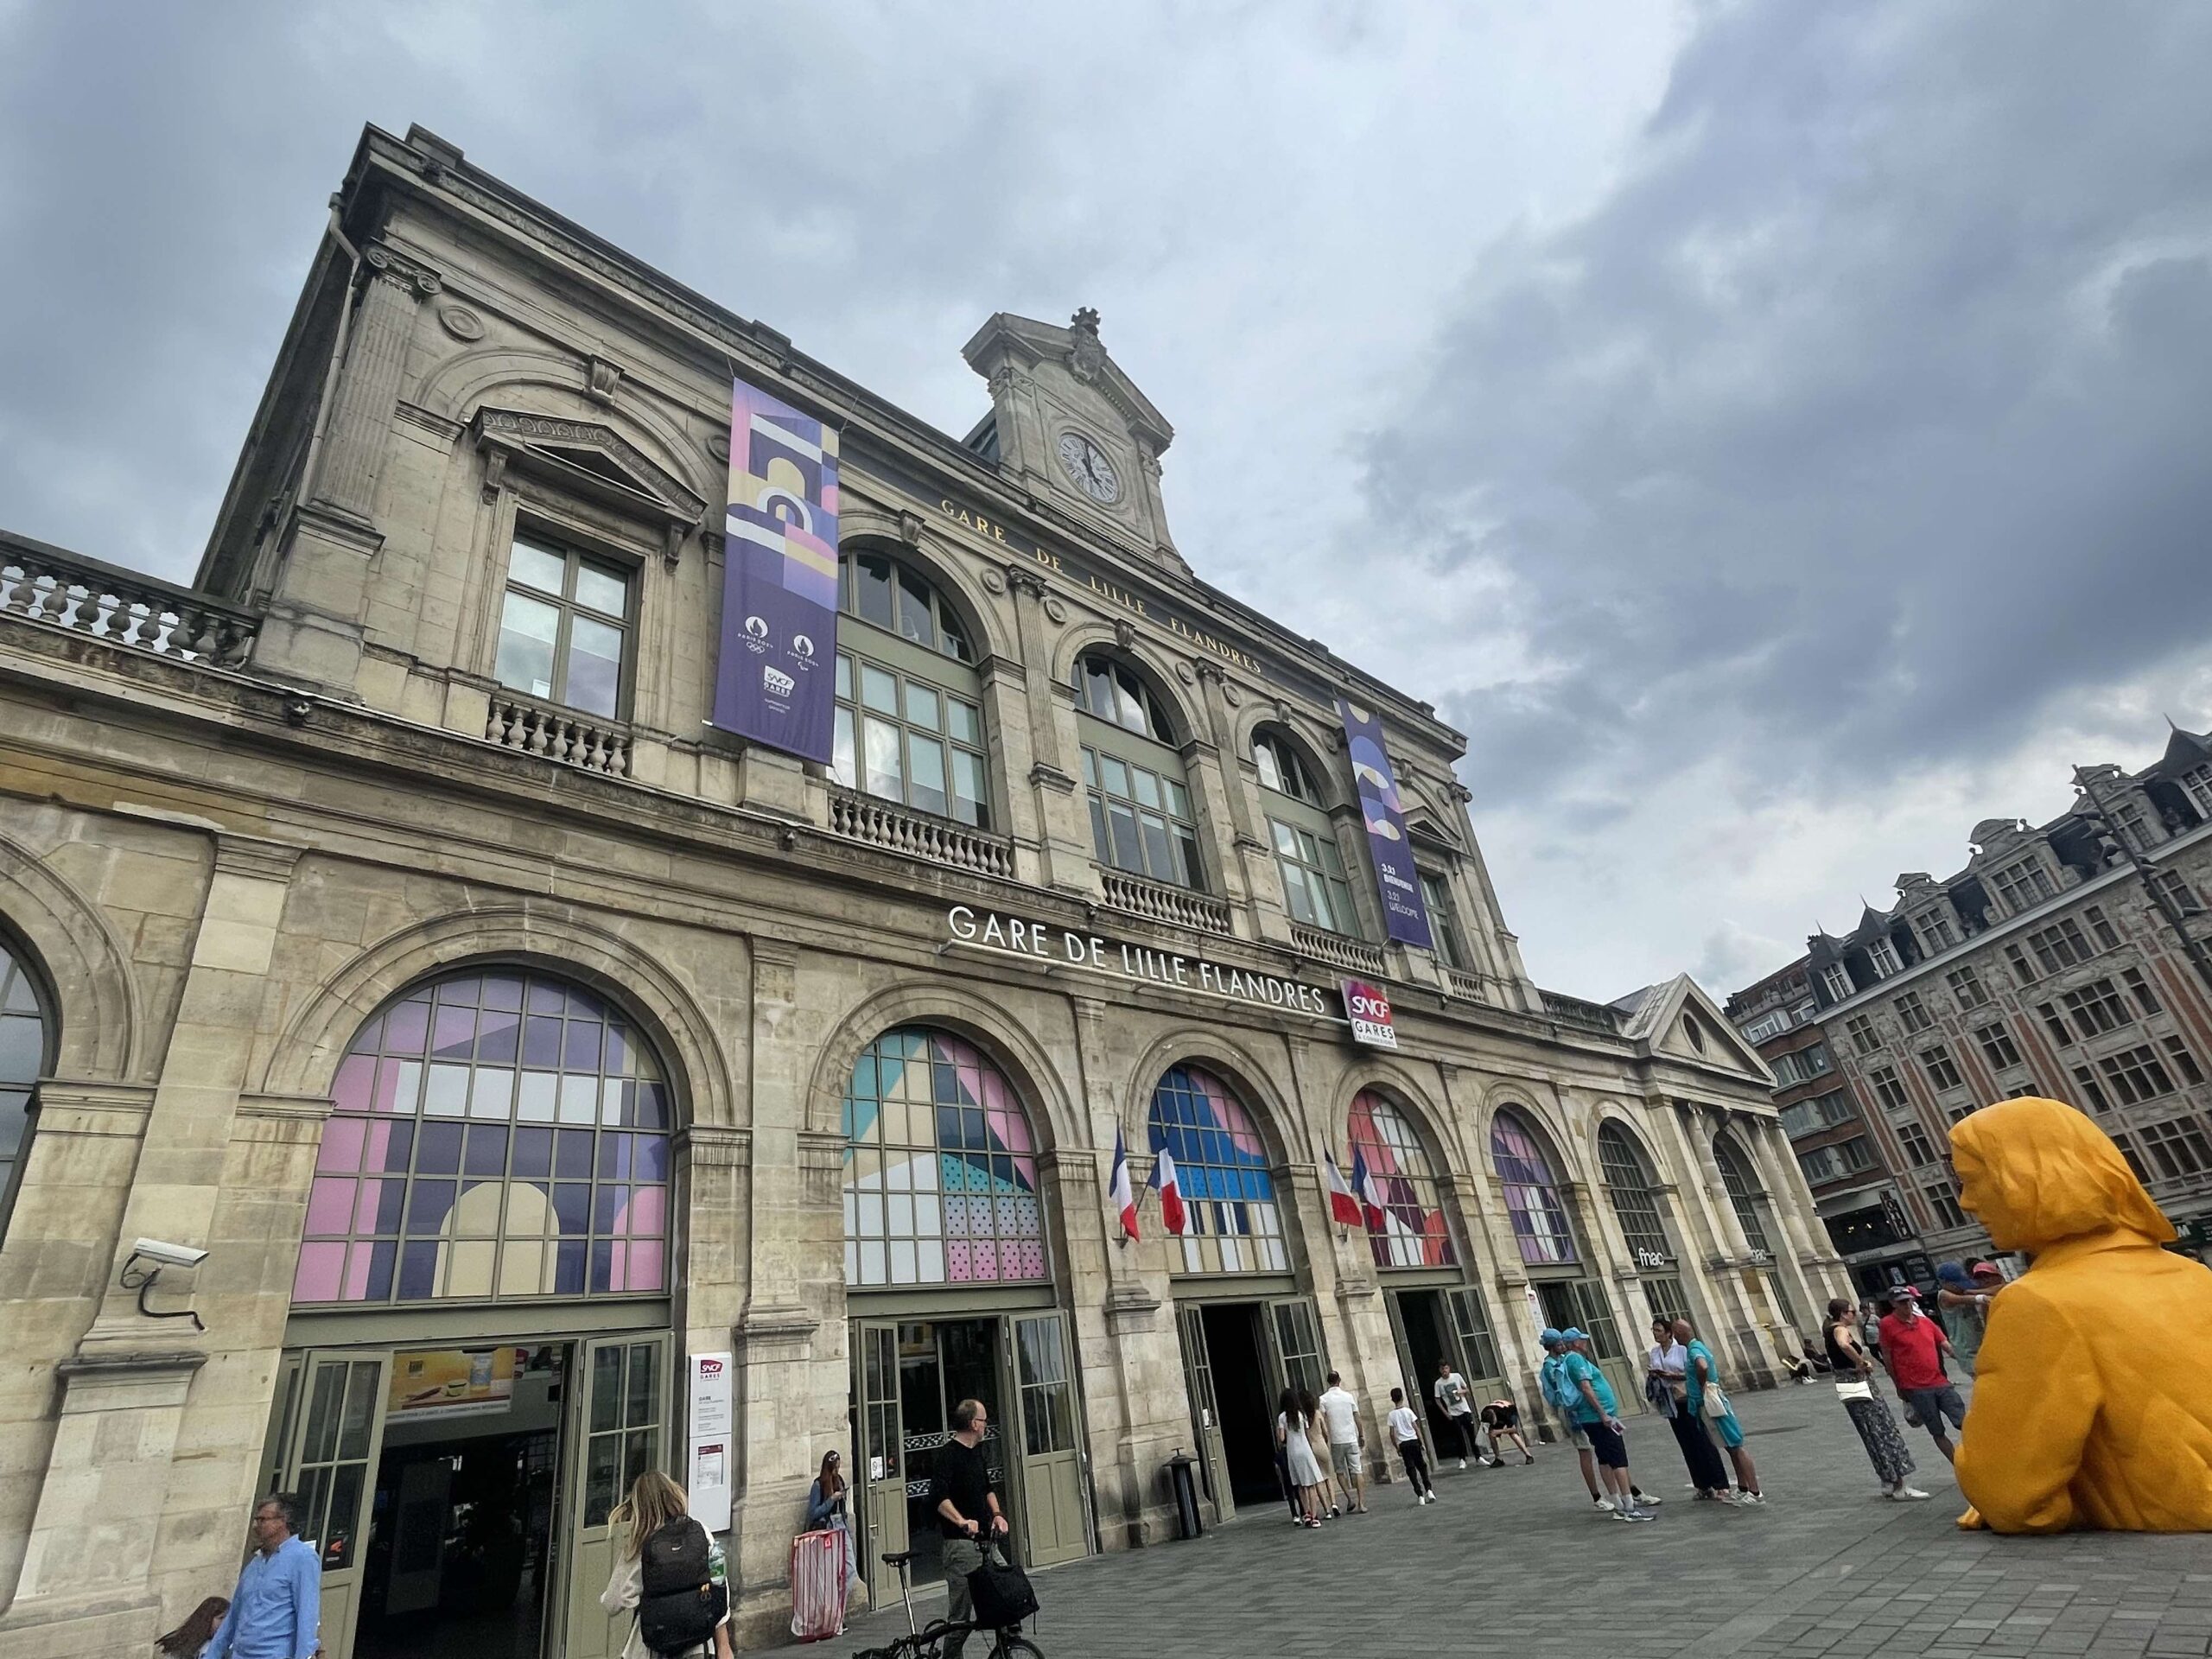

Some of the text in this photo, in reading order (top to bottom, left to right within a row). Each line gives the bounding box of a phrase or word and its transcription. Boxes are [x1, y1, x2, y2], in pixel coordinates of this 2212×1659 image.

[941, 499, 1262, 673] GARE DE LILLE FLANDRES
[766, 672, 791, 686] SNCF
[947, 905, 1325, 1014] GARE DE LILLE FLANDRES
[1351, 995, 1391, 1019] SNCF
[1355, 1021, 1395, 1040] GARES
[1638, 1247, 1665, 1268] fnac
[701, 1363, 721, 1373] SNCF
